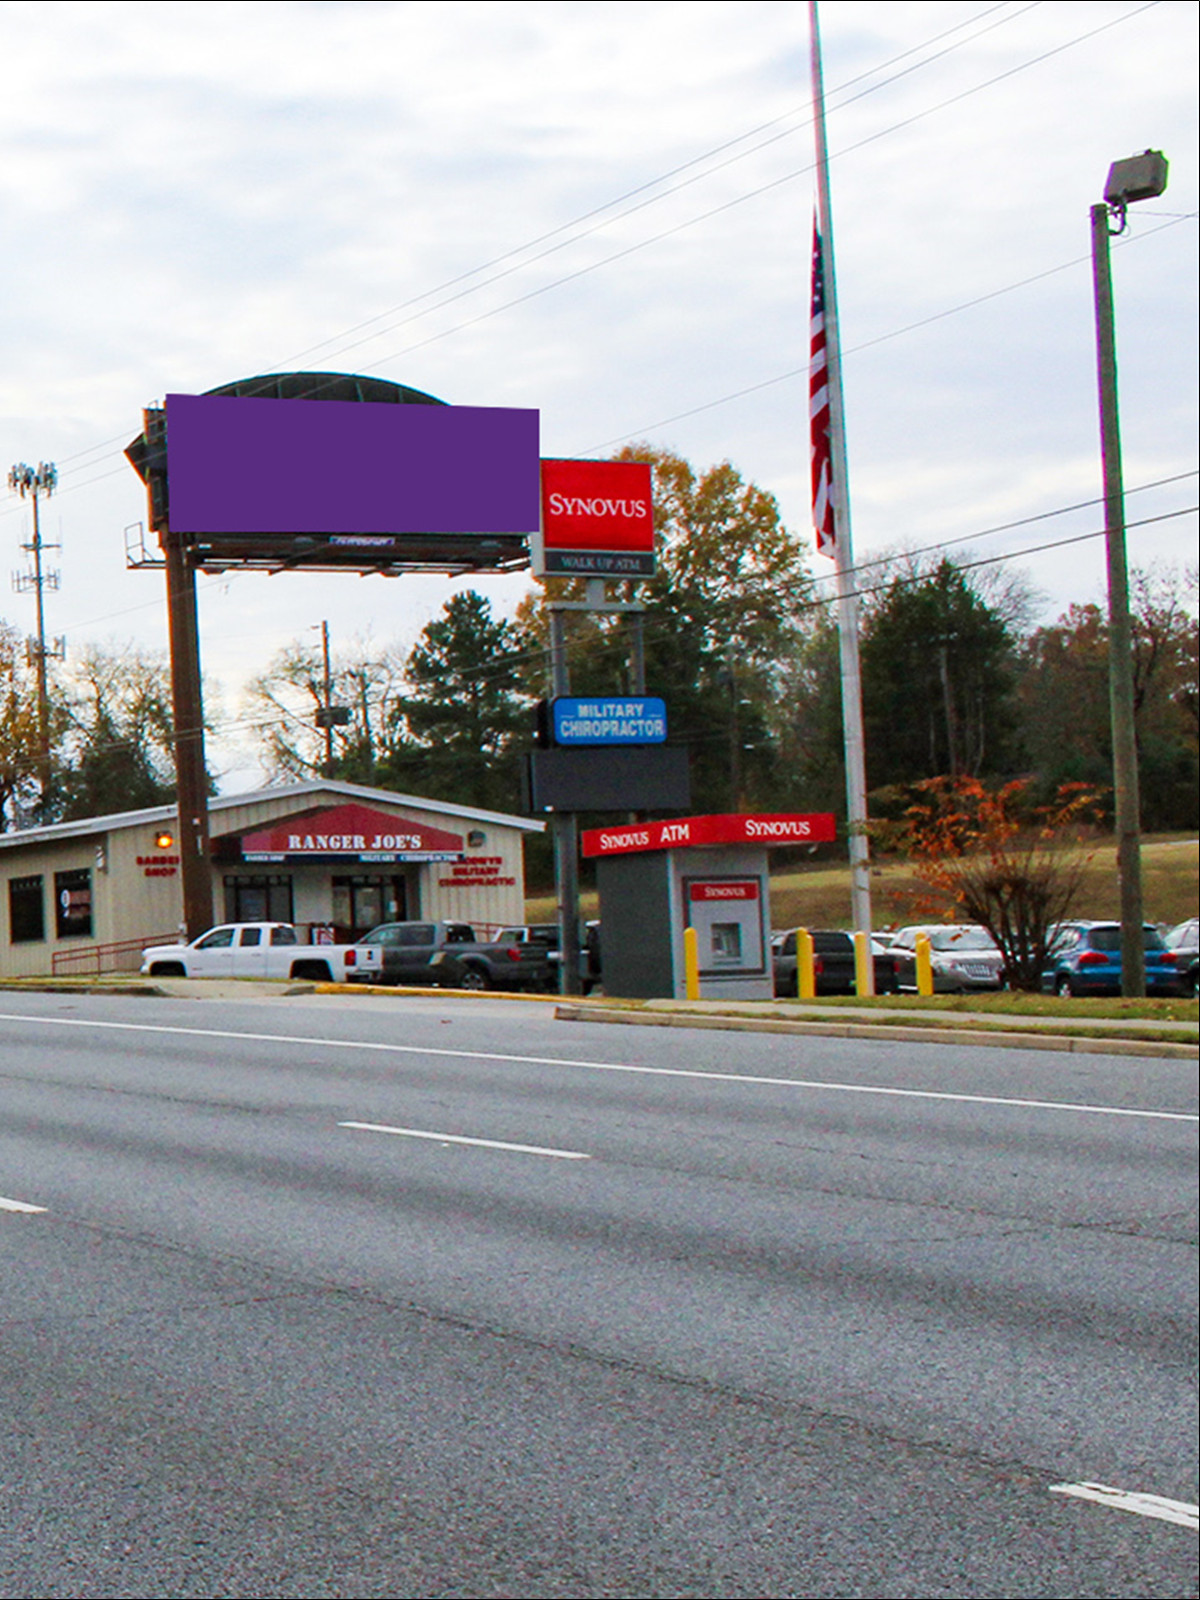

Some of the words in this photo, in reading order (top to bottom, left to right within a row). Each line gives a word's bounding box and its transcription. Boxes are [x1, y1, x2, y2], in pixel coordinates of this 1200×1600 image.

[549, 493, 647, 518] SYNOVUS
[561, 556, 595, 569] WALK
[597, 557, 613, 569] UP
[615, 558, 640, 570] ATM
[578, 704, 644, 718] MILITARY
[561, 720, 665, 737] CHIROPRACTOR
[745, 819, 811, 836] SYNOVUS
[288, 834, 366, 849] RANGER
[371, 834, 422, 849] JOE'S
[600, 831, 649, 850] SYNOVUS
[660, 824, 690, 842] ATM
[144, 867, 177, 877] SHOP
